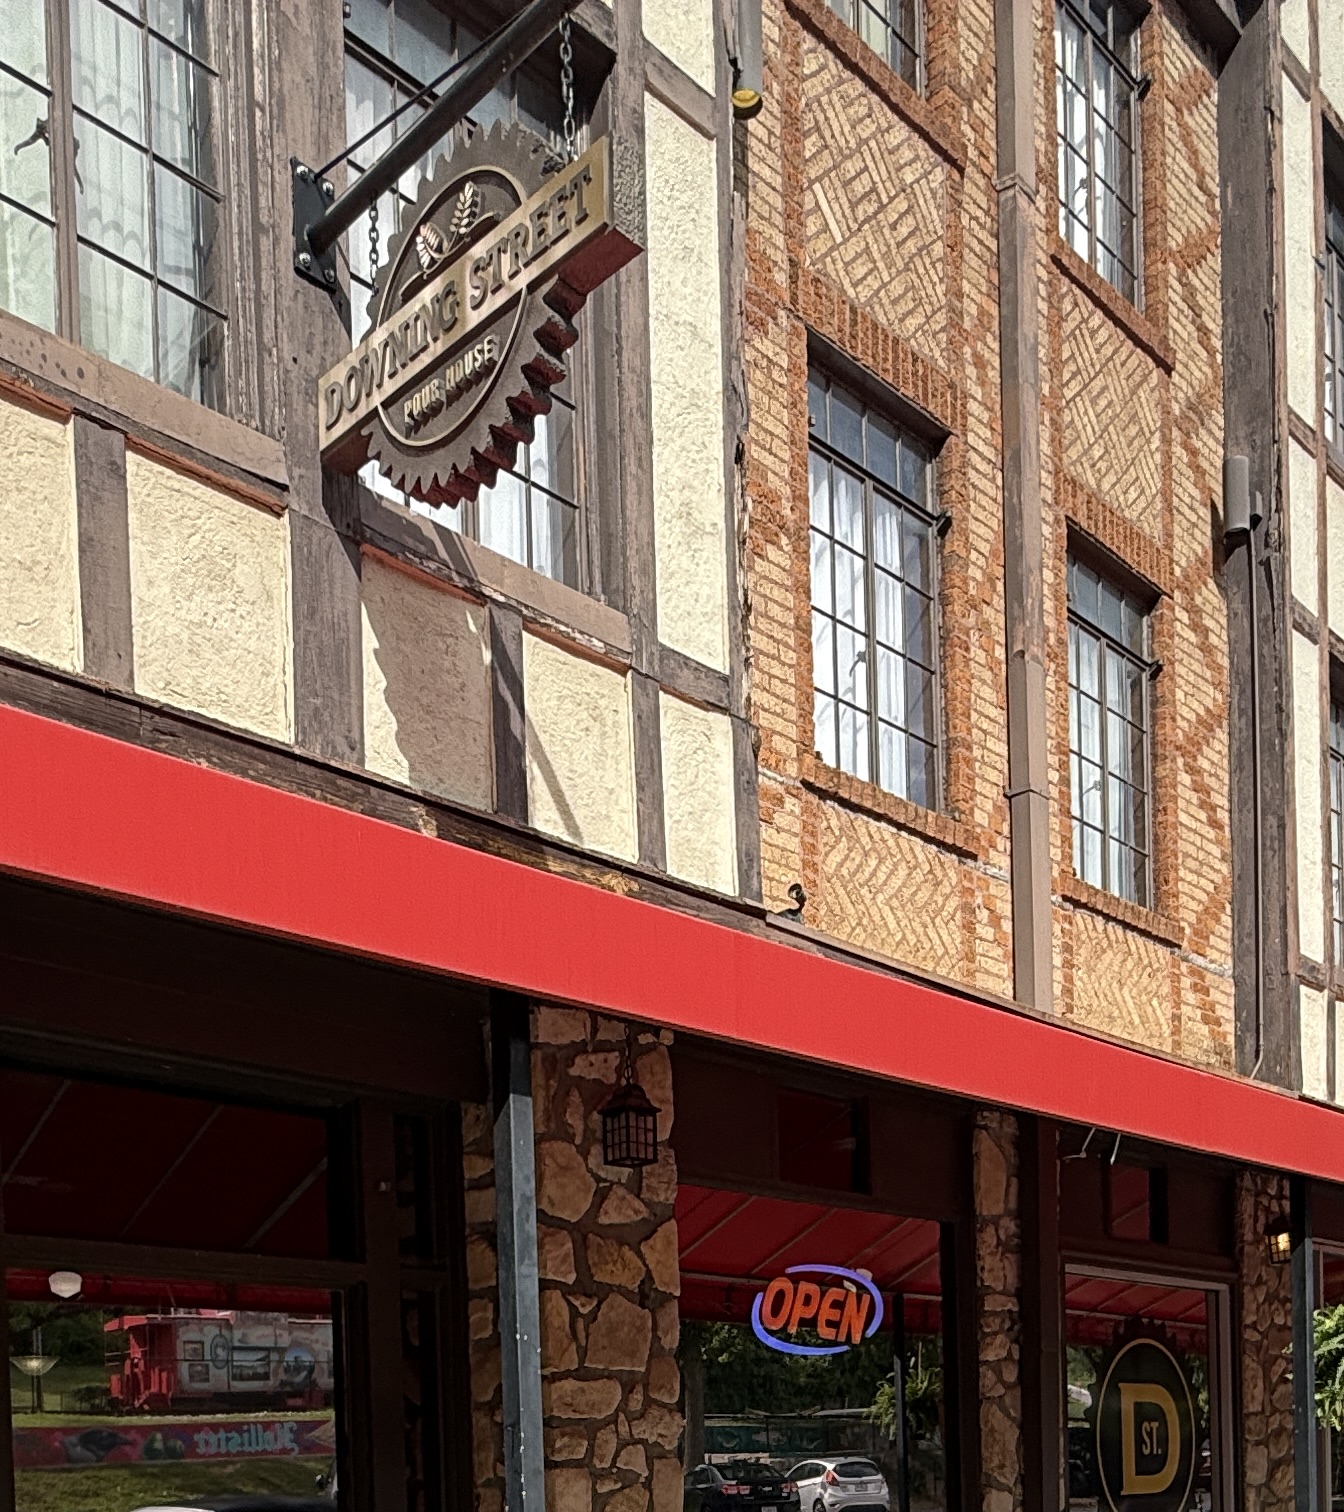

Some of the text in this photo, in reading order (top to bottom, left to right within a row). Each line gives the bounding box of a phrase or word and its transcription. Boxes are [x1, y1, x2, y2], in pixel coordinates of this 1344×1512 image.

[324, 164, 593, 431] DOWNING STREET
[404, 334, 501, 424] POUR HOUSE
[762, 1276, 871, 1345] OPEN
[1118, 1382, 1181, 1496] D
